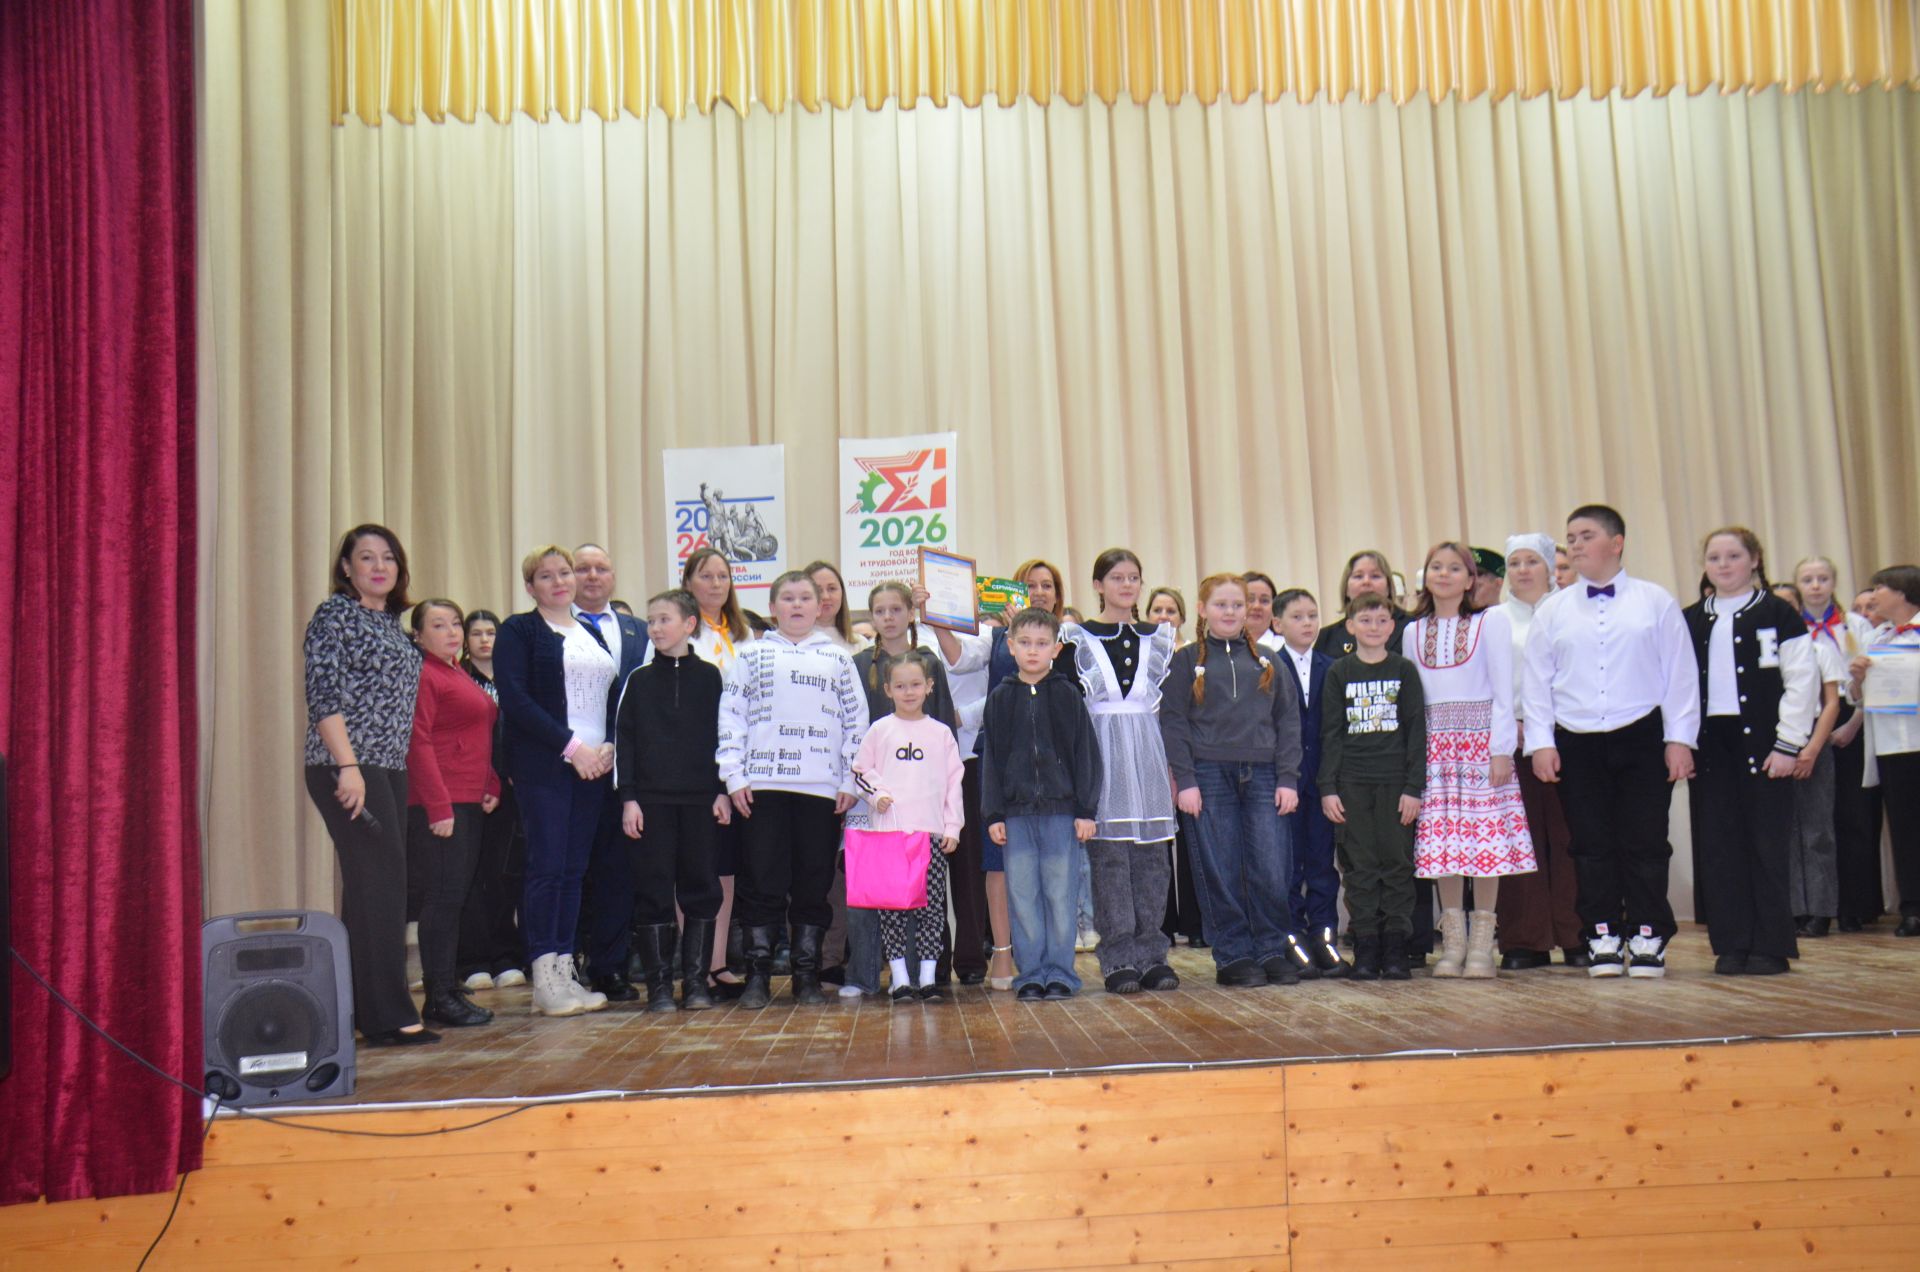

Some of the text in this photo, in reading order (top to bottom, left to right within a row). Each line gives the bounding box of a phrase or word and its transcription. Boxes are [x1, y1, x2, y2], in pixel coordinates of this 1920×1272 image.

[675, 507, 710, 532] 20
[860, 513, 947, 547] 2026
[676, 533, 711, 558] 26
[868, 558, 908, 568] ТРУДОВОЙ
[731, 574, 762, 582] ОССИИ
[896, 742, 924, 760] alo
